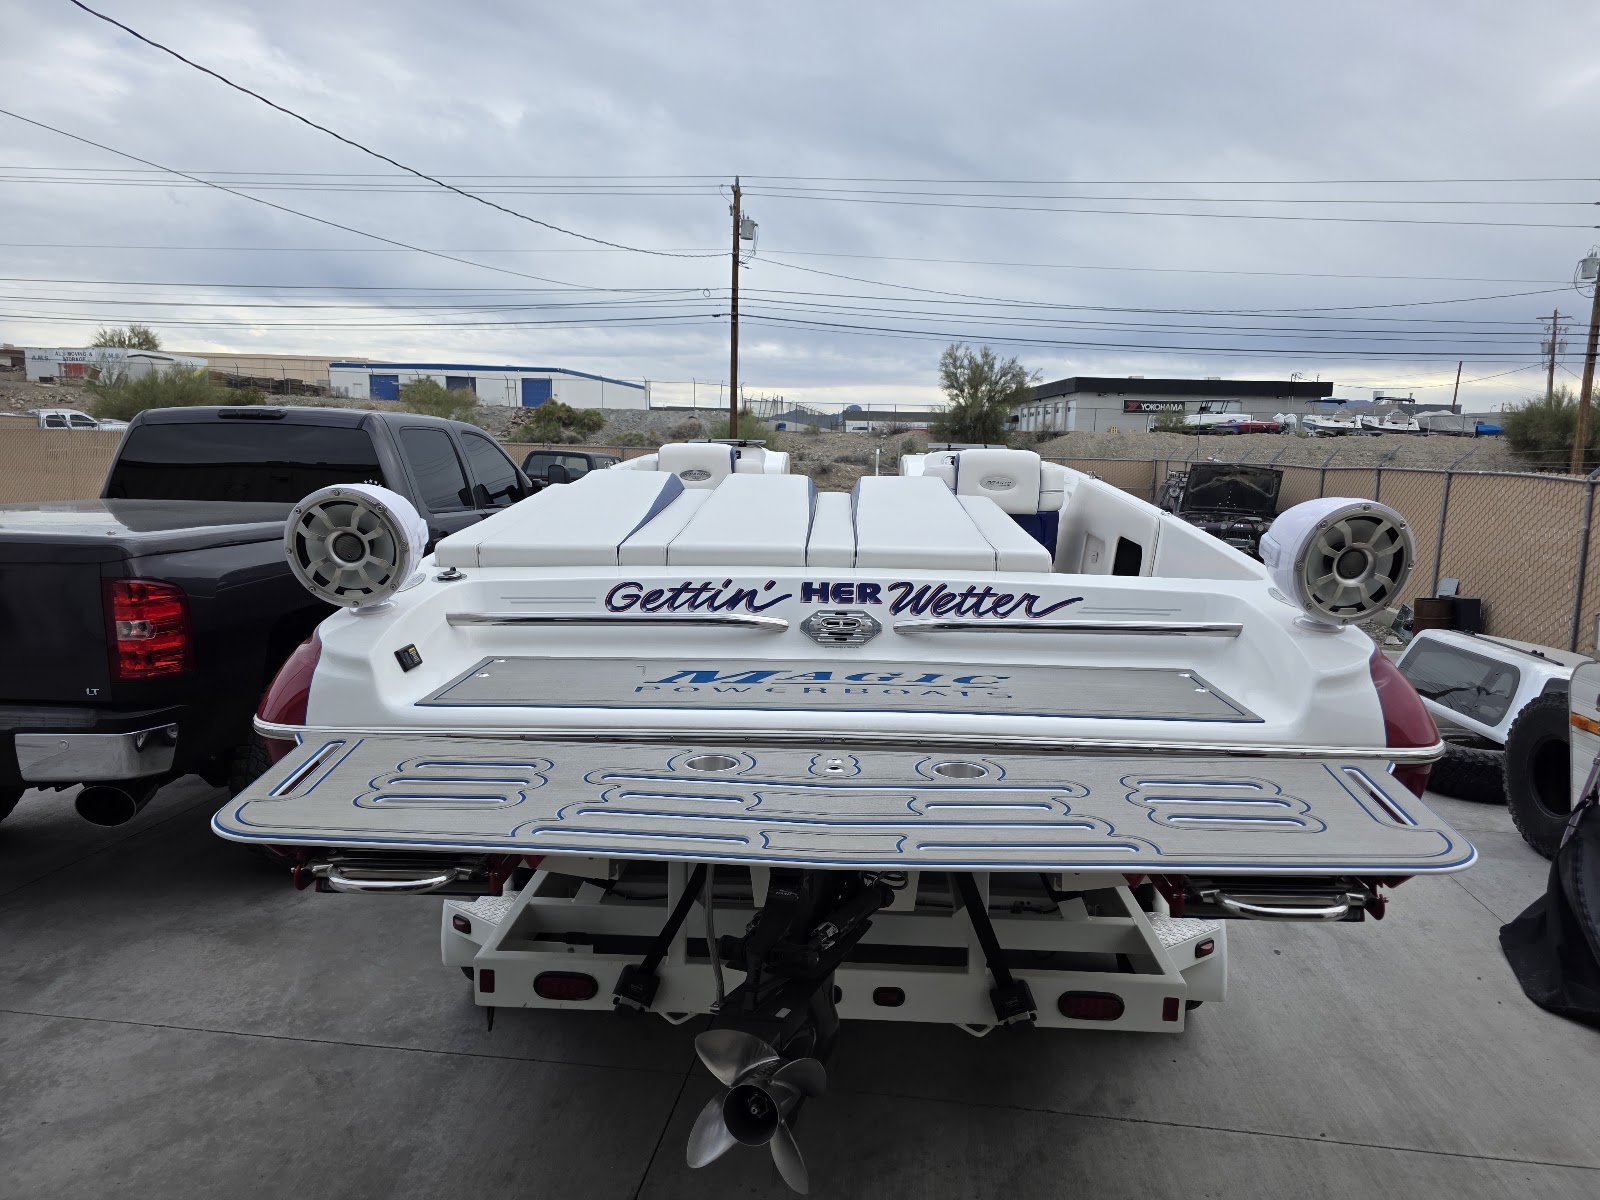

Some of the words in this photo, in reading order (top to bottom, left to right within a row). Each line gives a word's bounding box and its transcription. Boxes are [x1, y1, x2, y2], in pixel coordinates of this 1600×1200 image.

[1140, 403, 1184, 411] YOKOHAMA
[605, 578, 793, 613] Gettin'
[800, 581, 883, 605] HER
[888, 581, 1084, 619] Wetter
[643, 670, 1011, 686] MAGIC
[86, 687, 100, 696] LT
[634, 685, 1013, 699] POWERBOATS
